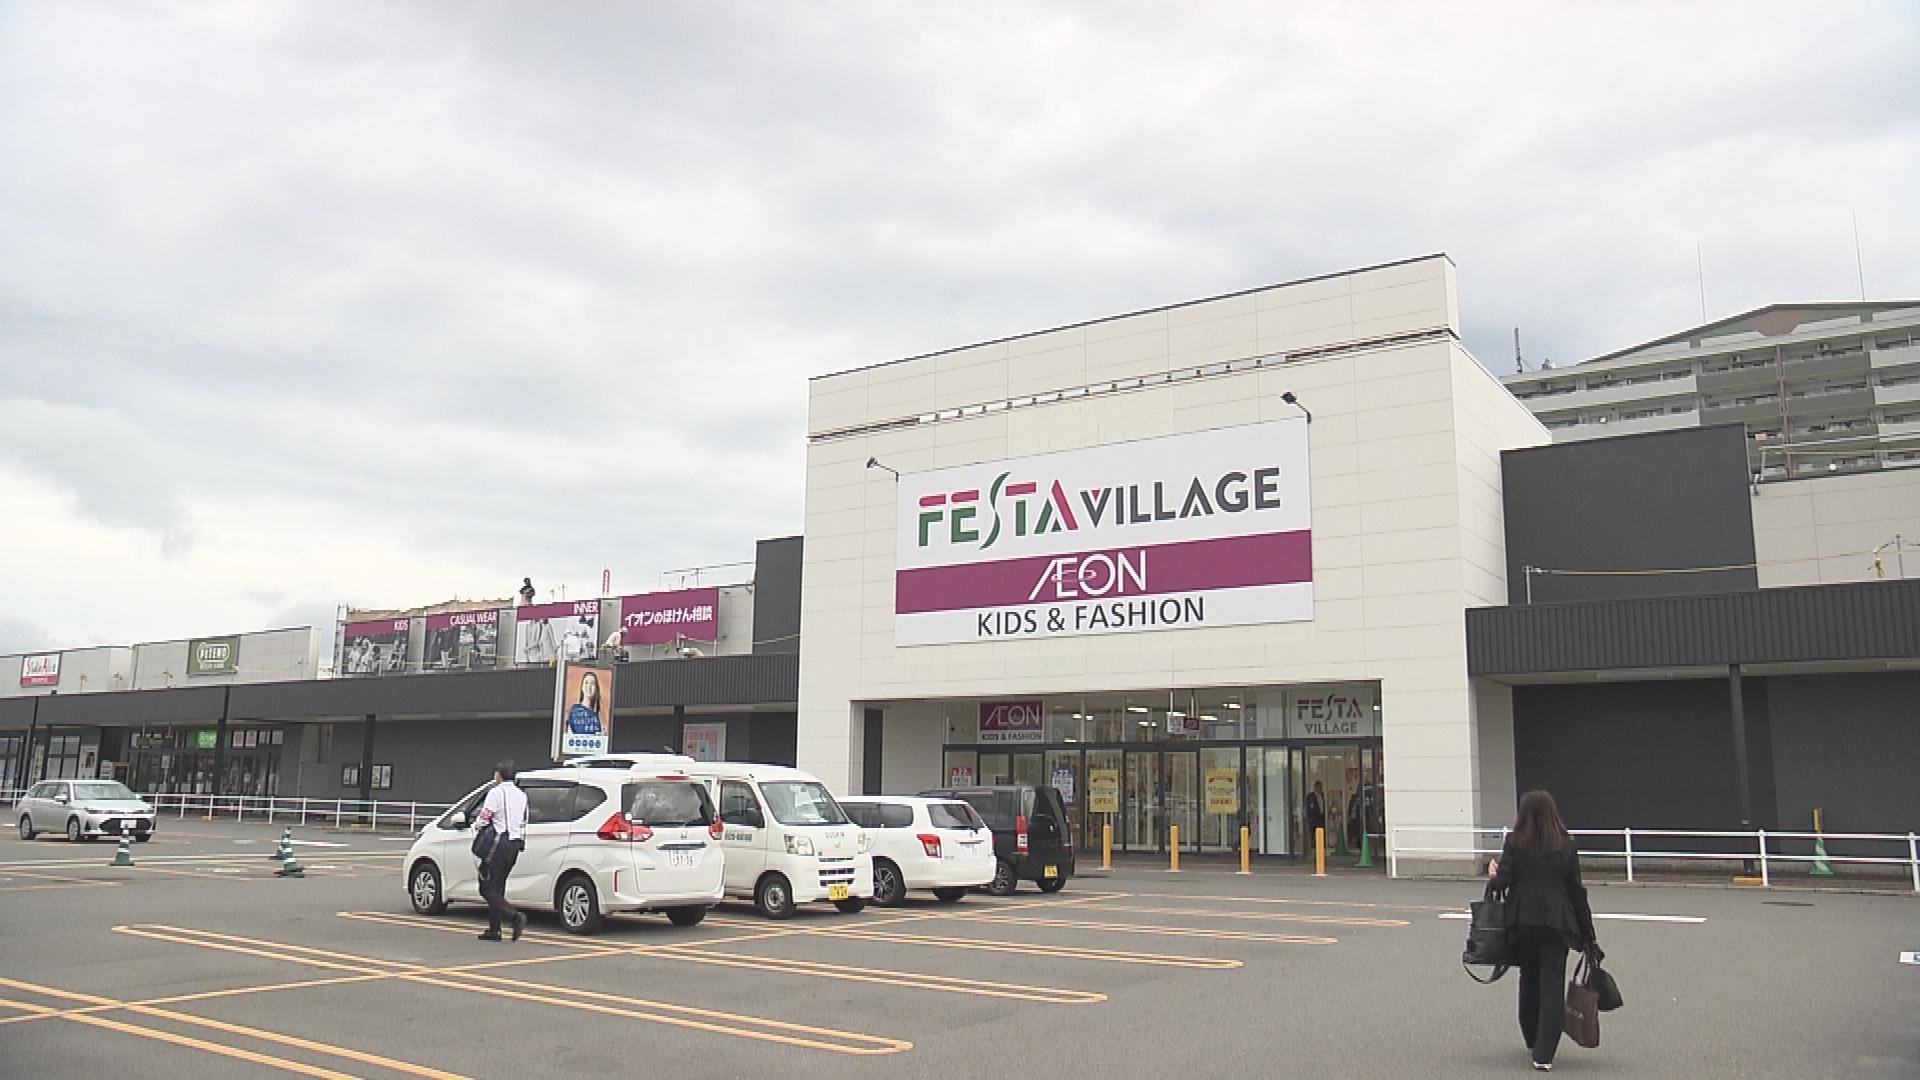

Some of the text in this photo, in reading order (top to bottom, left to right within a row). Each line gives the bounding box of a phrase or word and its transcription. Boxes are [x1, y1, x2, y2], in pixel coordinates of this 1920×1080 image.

[918, 467, 1281, 550] FESTA VILLAGE
[573, 601, 599, 615] INNER
[624, 605, 713, 627] イオンのほけん相談
[450, 611, 498, 627] CASUAL WEAR
[977, 596, 1204, 637] KIDS & FASHION
[393, 619, 409, 631] KIDS
[1297, 693, 1364, 721] FESTA
[981, 732, 999, 741] KIDS
[1008, 731, 1042, 741] FASHION
[1304, 721, 1358, 735] VILLAGE
